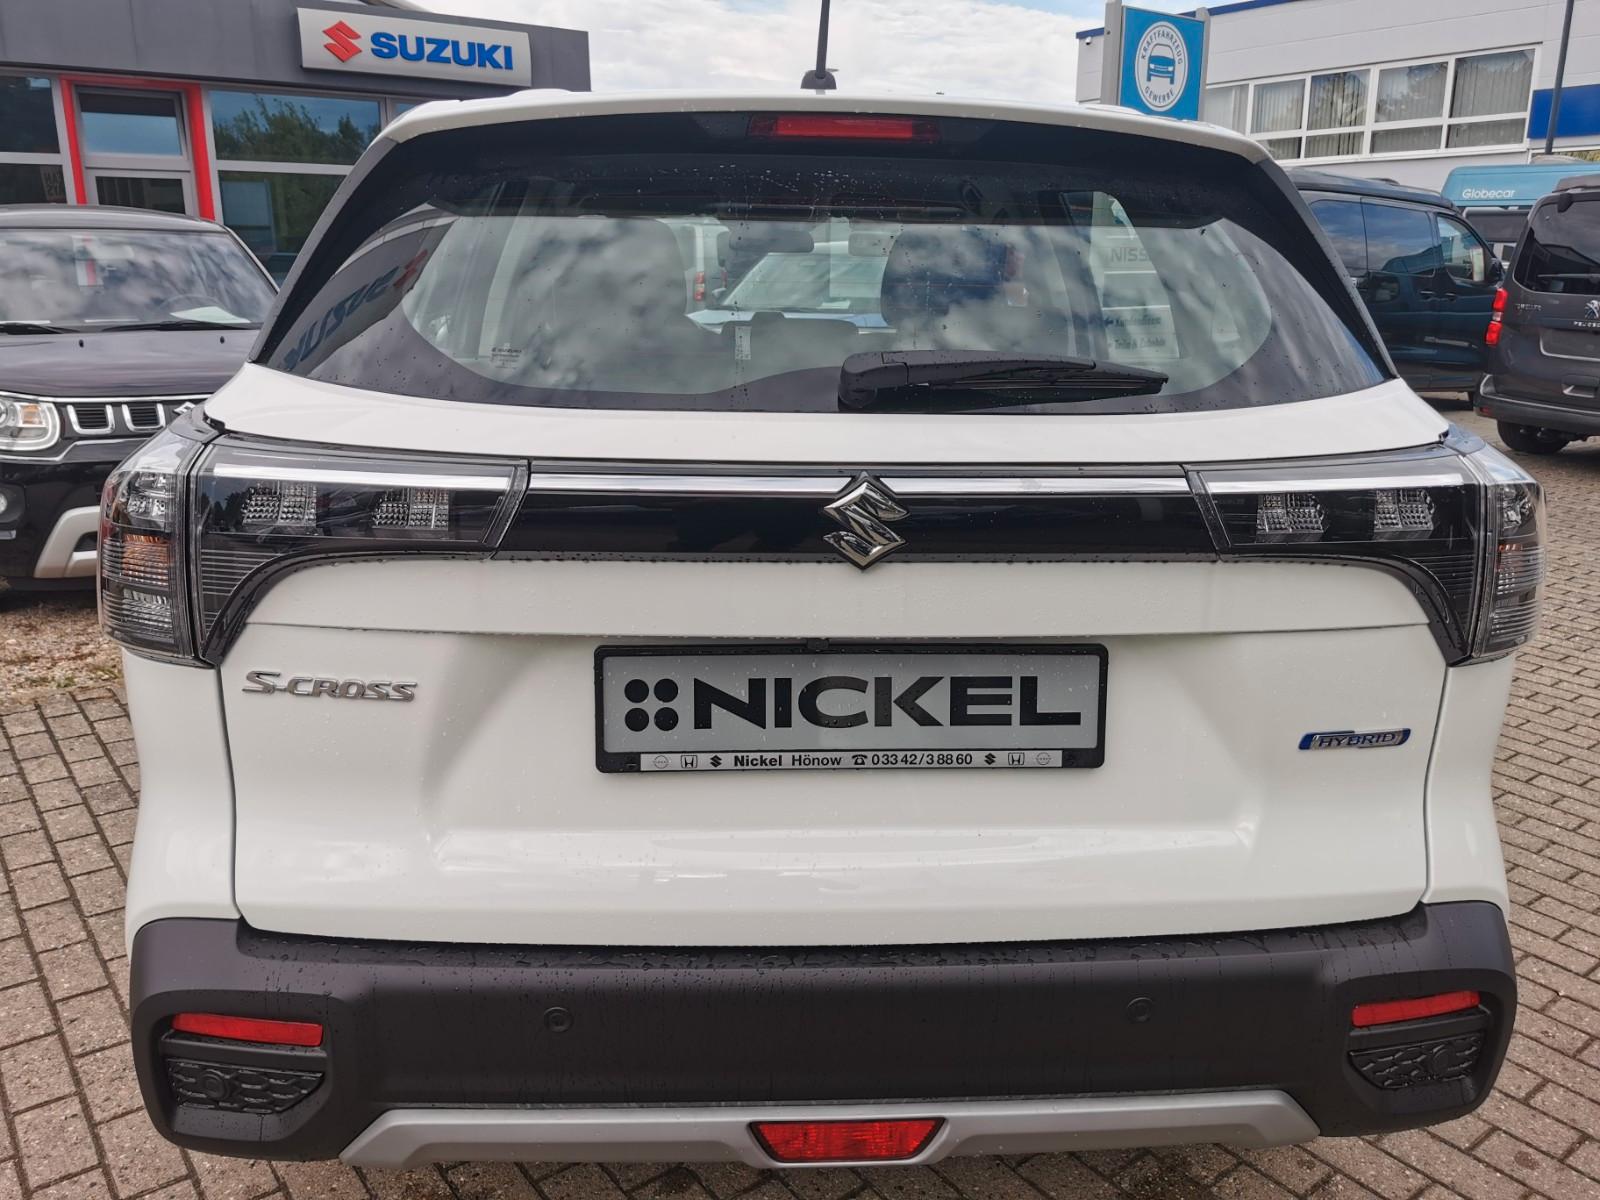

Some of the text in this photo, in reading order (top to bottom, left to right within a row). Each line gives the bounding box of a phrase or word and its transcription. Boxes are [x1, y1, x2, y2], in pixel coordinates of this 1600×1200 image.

[370, 31, 514, 71] SUZUKI
[1140, 29, 1184, 65] KRAFTFAHRZEUG
[1144, 86, 1175, 104] GEWERBE
[1462, 187, 1516, 199] Globecar
[242, 670, 418, 702] S-CROSS
[693, 676, 1082, 730] NICKEL
[1318, 733, 1397, 747] HYBRID
[733, 754, 783, 767] Nickel
[791, 753, 843, 767] Hönow
